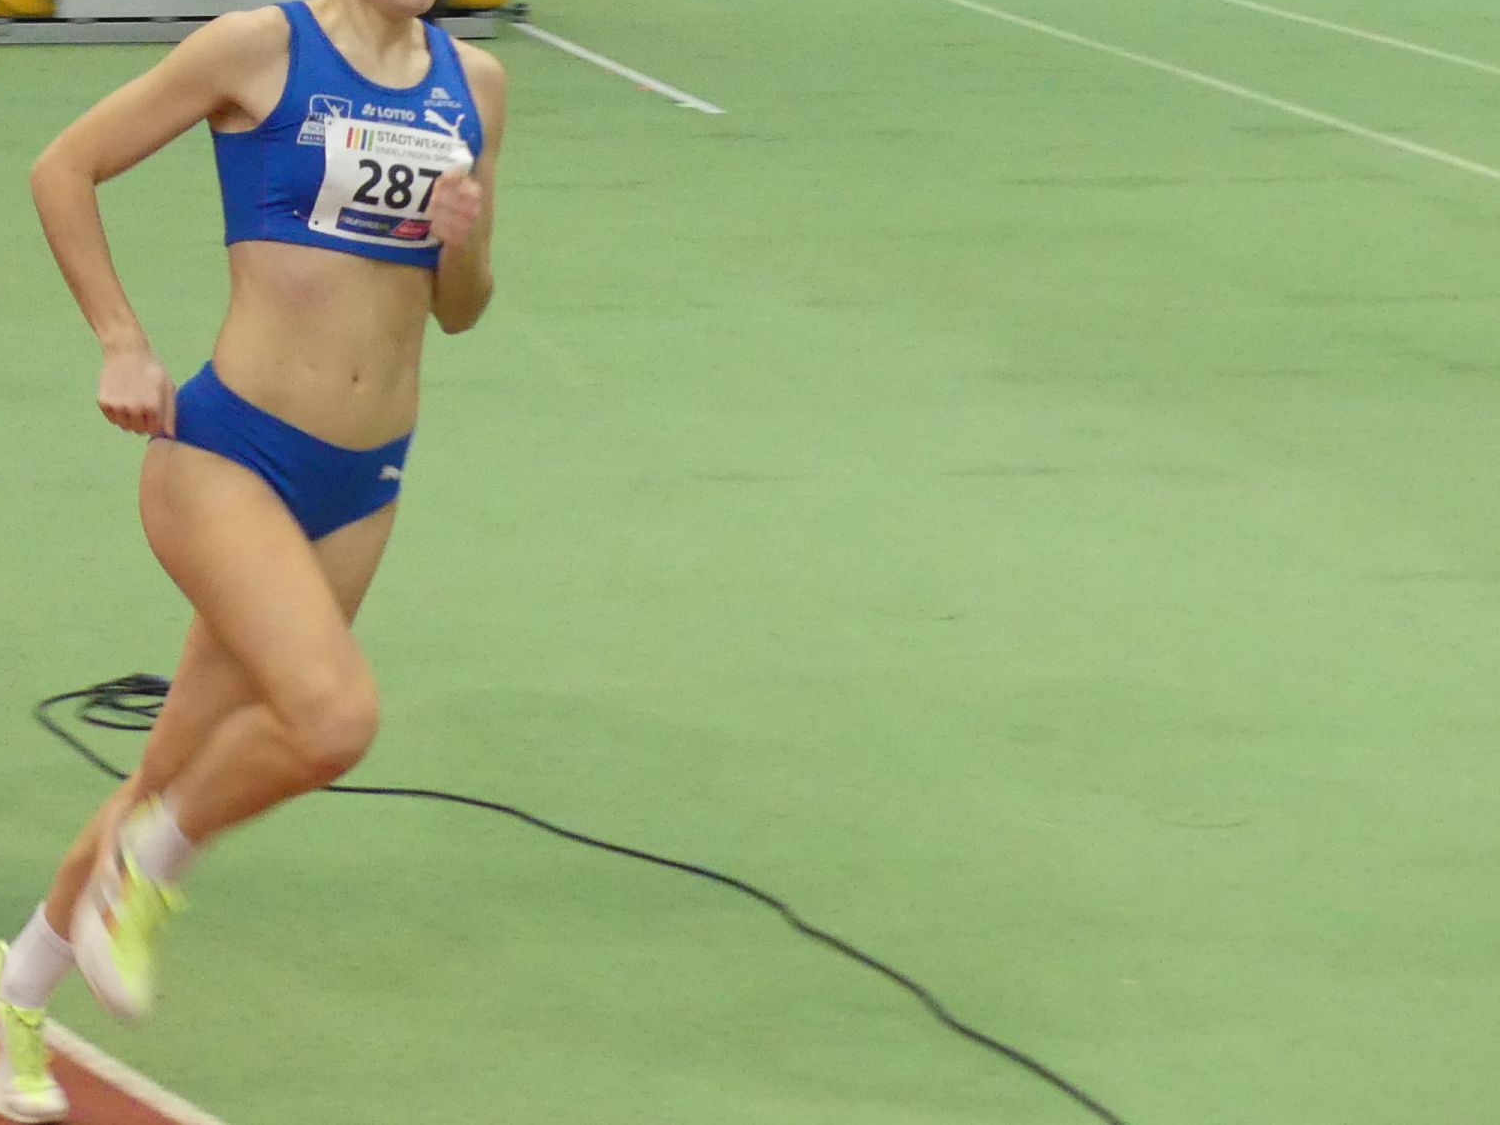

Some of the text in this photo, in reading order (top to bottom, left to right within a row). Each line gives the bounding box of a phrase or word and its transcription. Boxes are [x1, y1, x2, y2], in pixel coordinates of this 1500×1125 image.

[377, 106, 416, 122] LOTTO
[376, 130, 453, 151] STADTWERKE
[352, 158, 443, 213] 287
